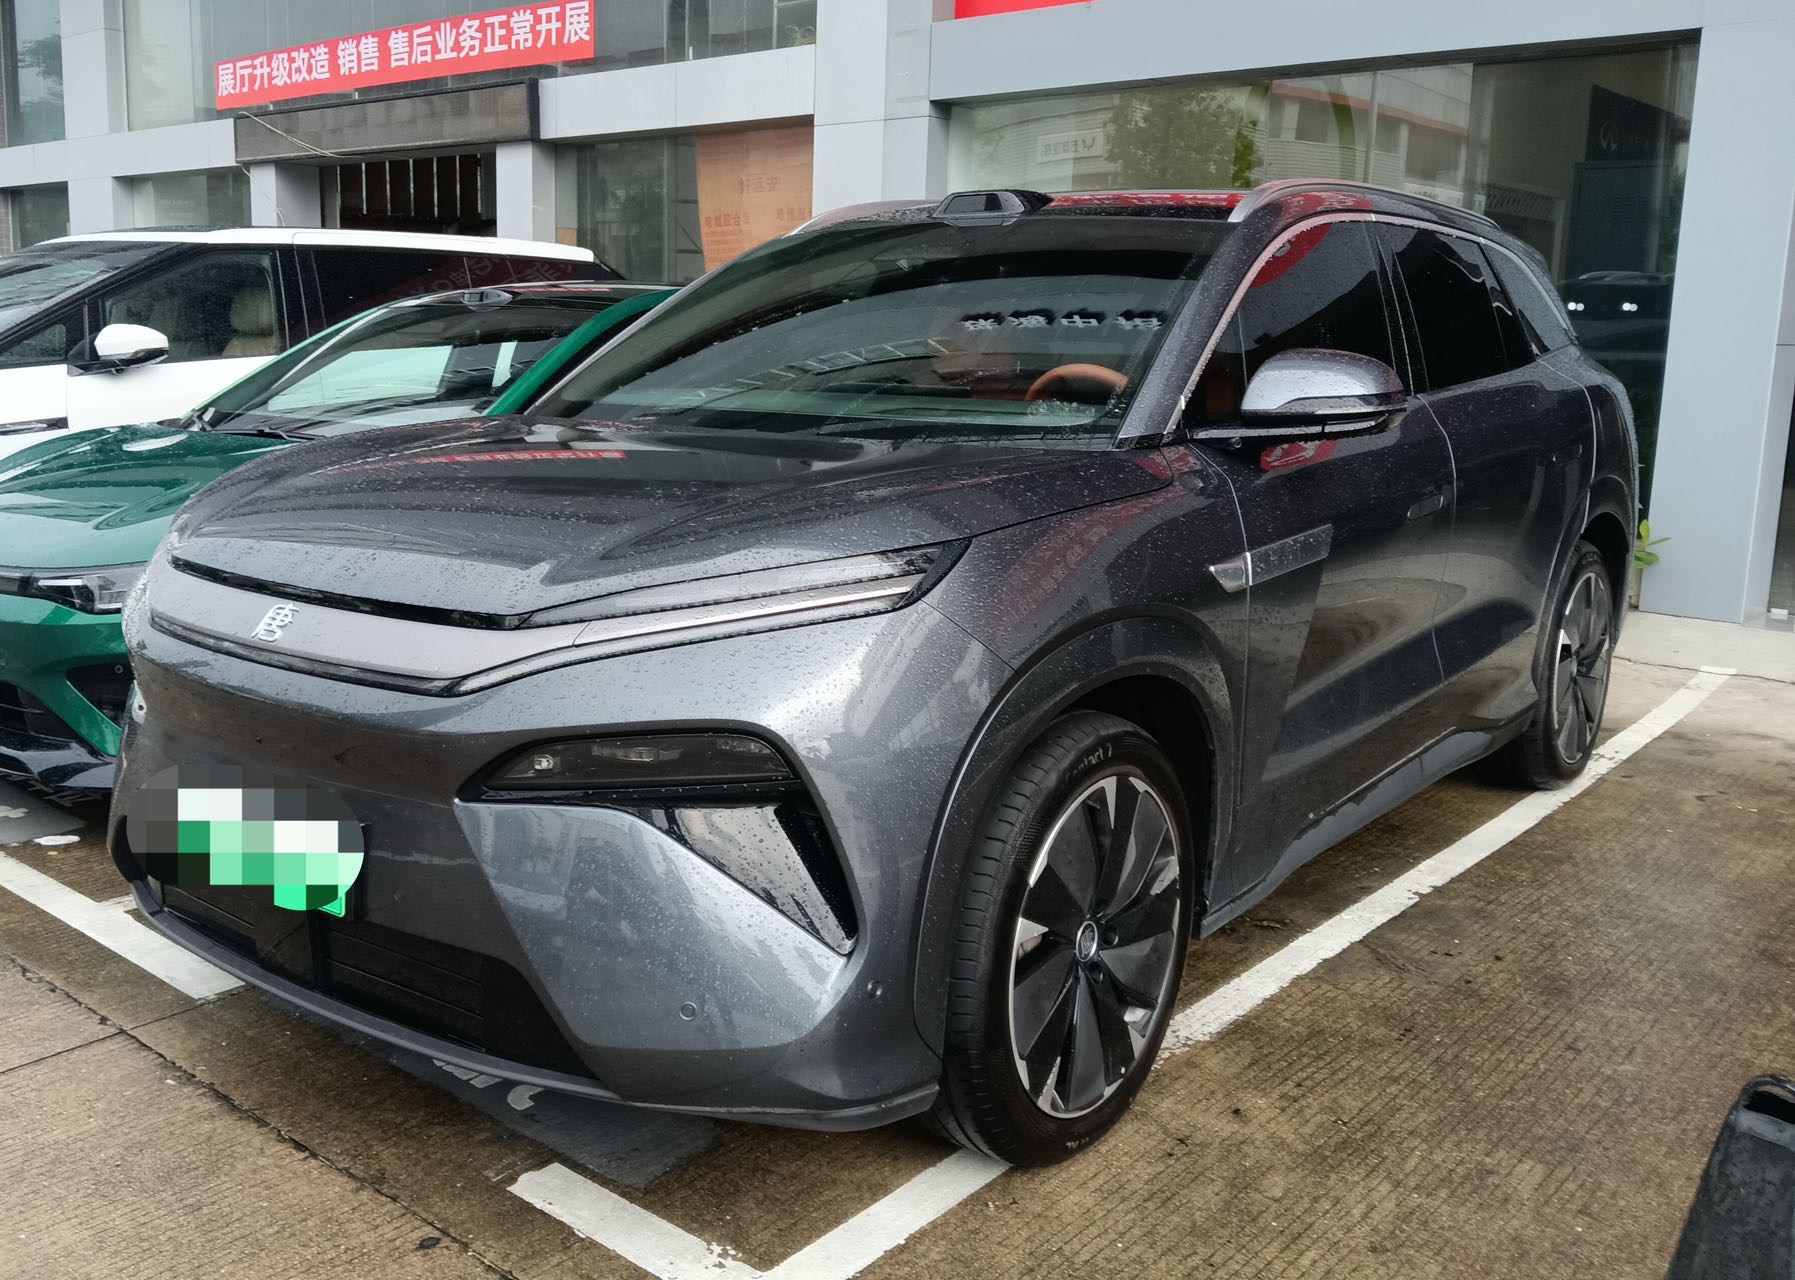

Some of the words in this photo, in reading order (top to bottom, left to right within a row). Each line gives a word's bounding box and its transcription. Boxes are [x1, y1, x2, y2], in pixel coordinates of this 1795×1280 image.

[218, 44, 330, 96] 展厅升级改造
[337, 35, 380, 75] 销售
[388, 1, 591, 68] 售后业务正常开展
